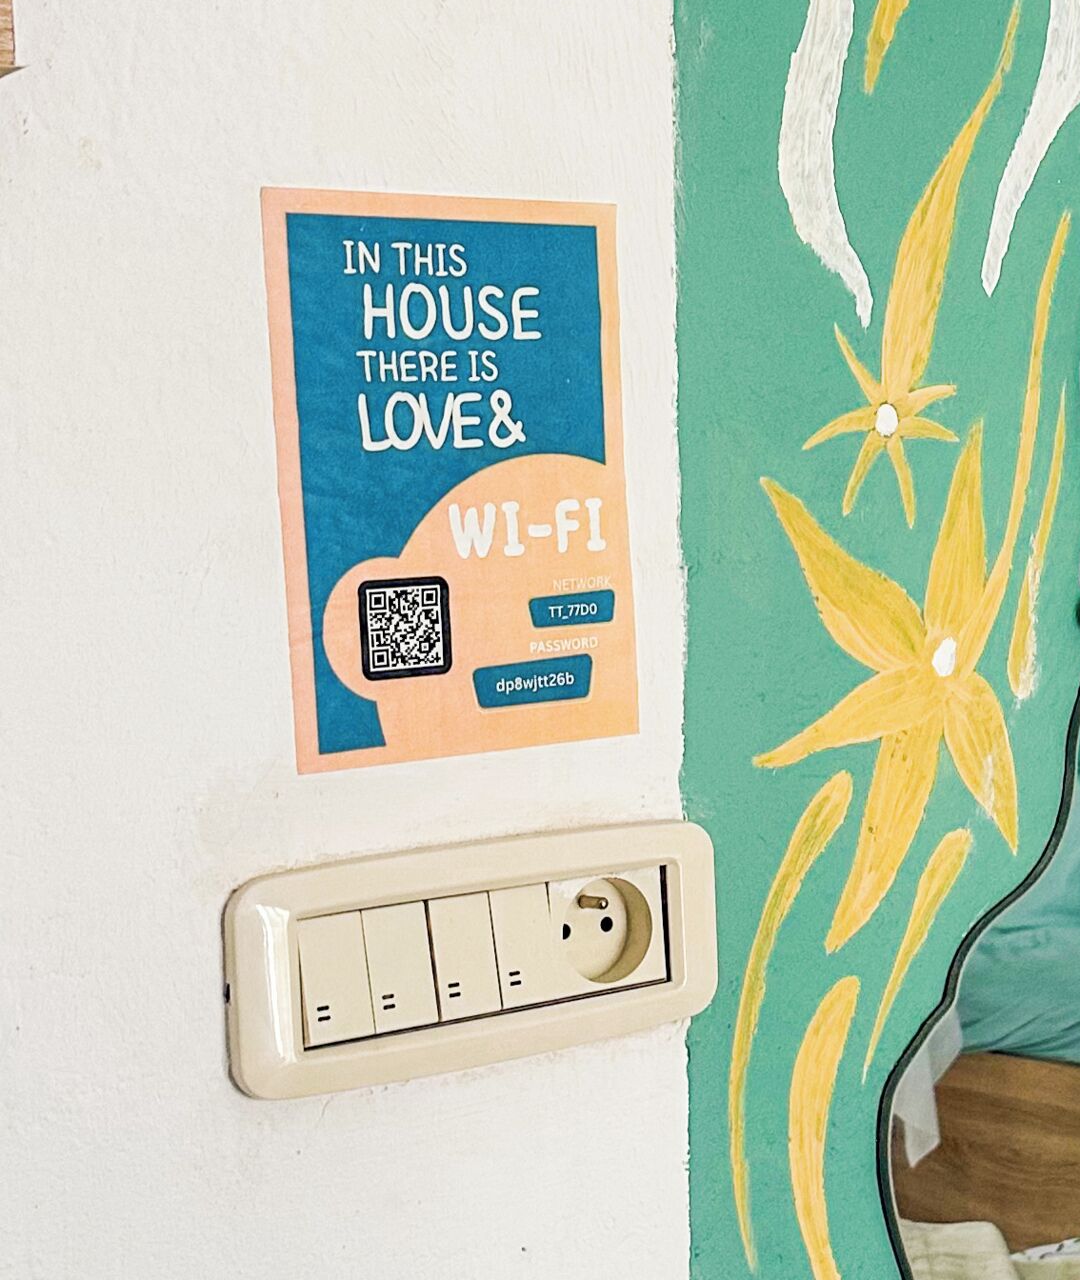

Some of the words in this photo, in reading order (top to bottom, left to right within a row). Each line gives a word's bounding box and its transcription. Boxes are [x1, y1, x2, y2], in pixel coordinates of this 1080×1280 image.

[342, 240, 381, 274] IN
[391, 242, 468, 277] THIS
[363, 282, 542, 340] HOUSE
[356, 350, 458, 382] THERE
[468, 350, 498, 382] IS
[448, 497, 607, 560] WI-FI
[553, 575, 613, 591] NETWORK
[529, 636, 599, 654] PASSWORD
[495, 671, 575, 695] dp8wjtt26b
